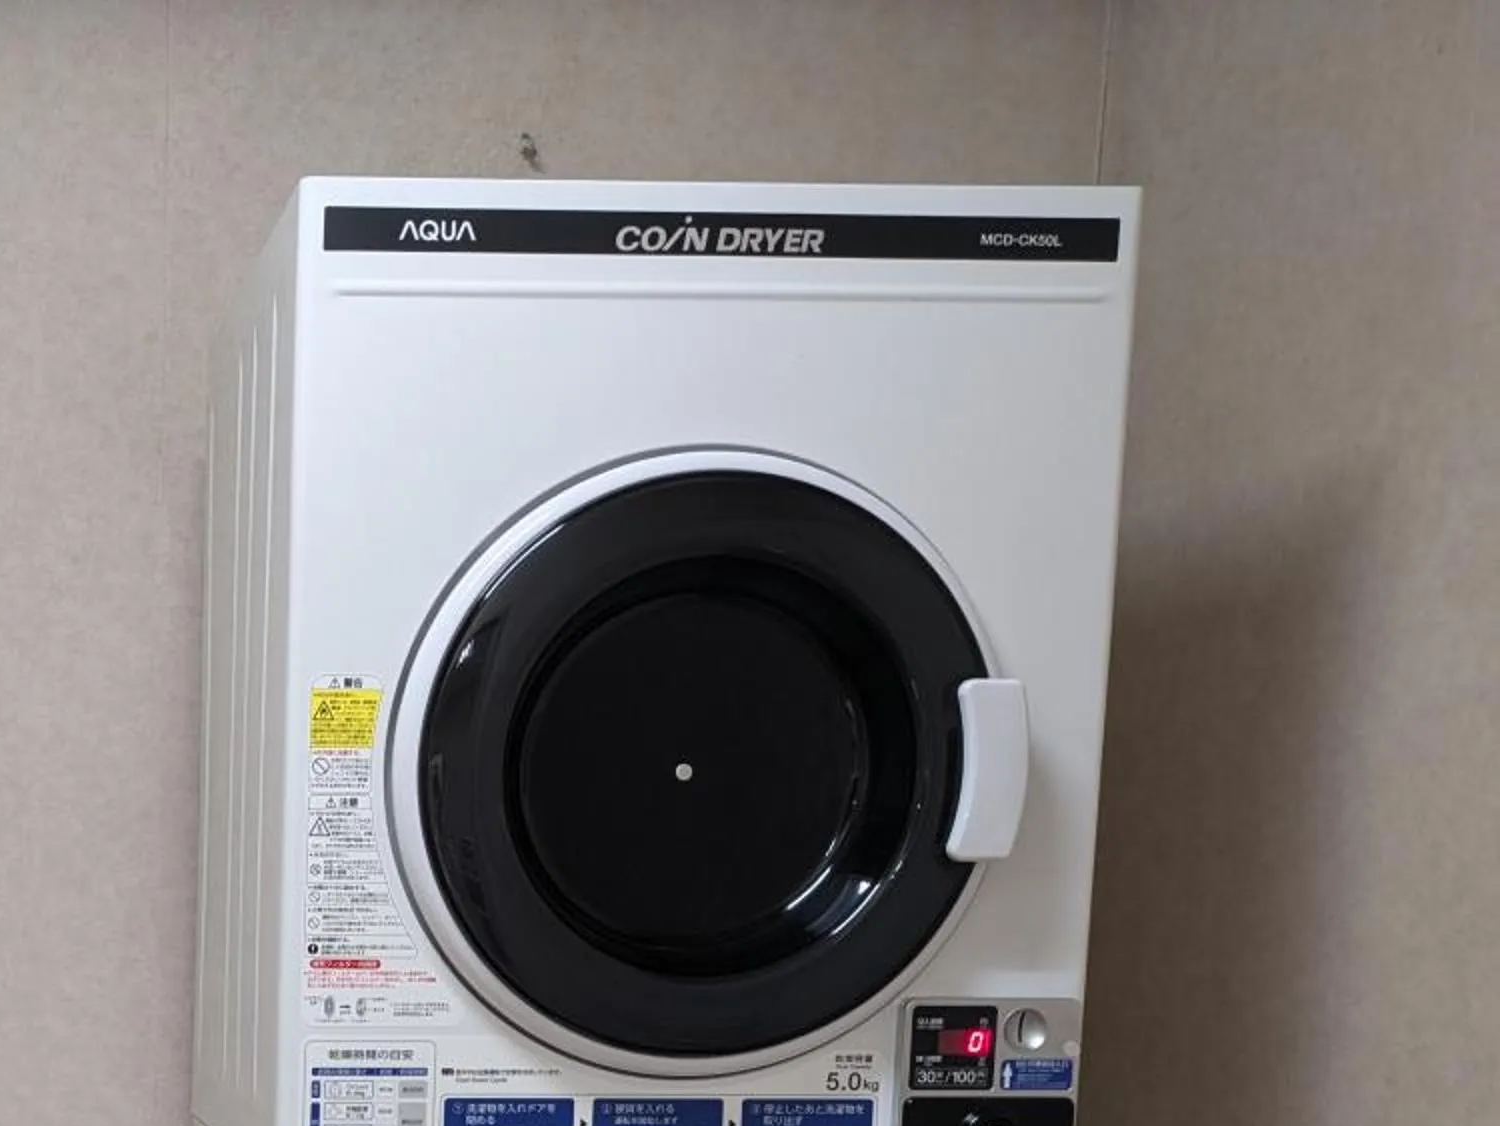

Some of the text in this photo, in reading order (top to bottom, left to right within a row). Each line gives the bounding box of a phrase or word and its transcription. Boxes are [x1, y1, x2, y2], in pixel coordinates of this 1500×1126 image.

[399, 219, 477, 242] AQUA
[615, 215, 825, 254] COIN DRYER
[979, 232, 1063, 247] MCD-CK50L
[967, 1031, 984, 1053] 0
